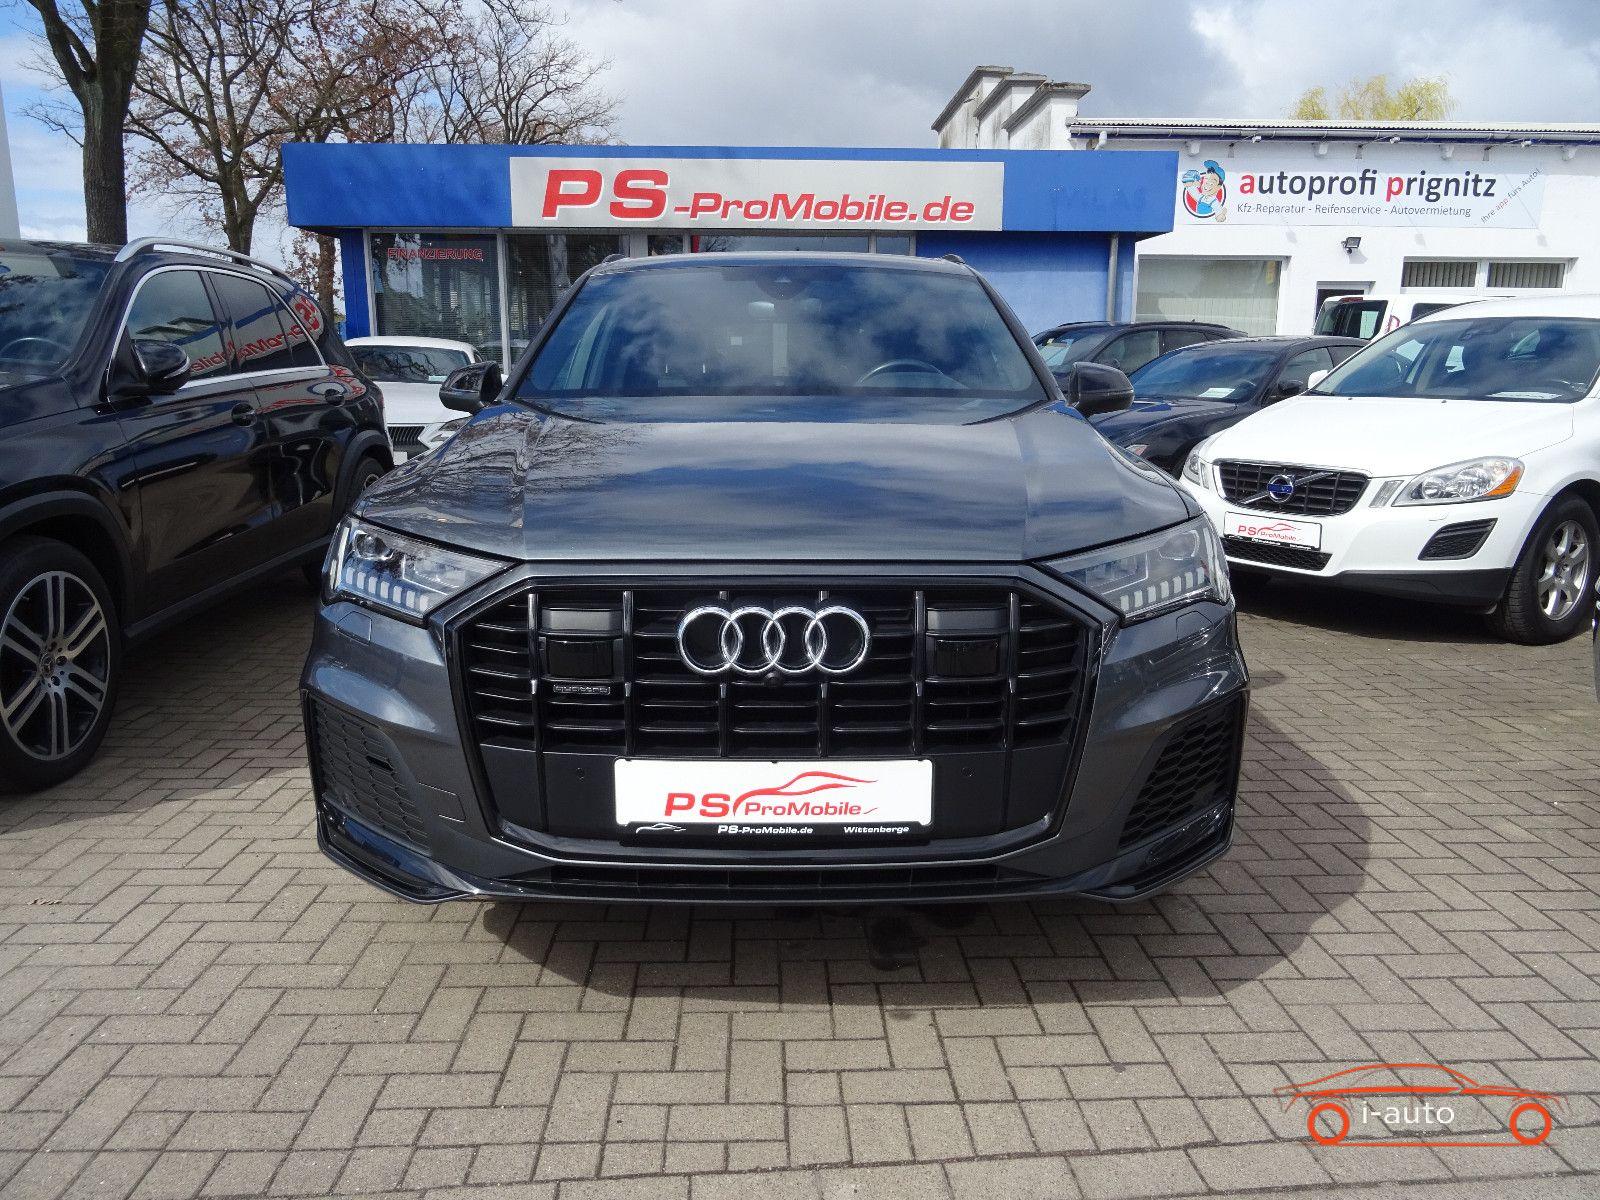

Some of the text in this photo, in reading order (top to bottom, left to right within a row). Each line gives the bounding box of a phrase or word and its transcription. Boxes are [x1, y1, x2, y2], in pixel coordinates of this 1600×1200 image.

[1239, 168, 1497, 203] autoprofi prignitz
[541, 168, 976, 223] PS-ProMobile.de
[1237, 203, 1306, 216] Kfz-Reparatur
[1315, 204, 1382, 215] Reifenservice
[1390, 205, 1472, 218] Autovermietung
[387, 247, 484, 260] FINANZIERUNG
[1237, 525, 1257, 536] PS
[664, 793, 862, 817] PS ProMobile
[717, 825, 813, 834] PS-ProMobile.de
